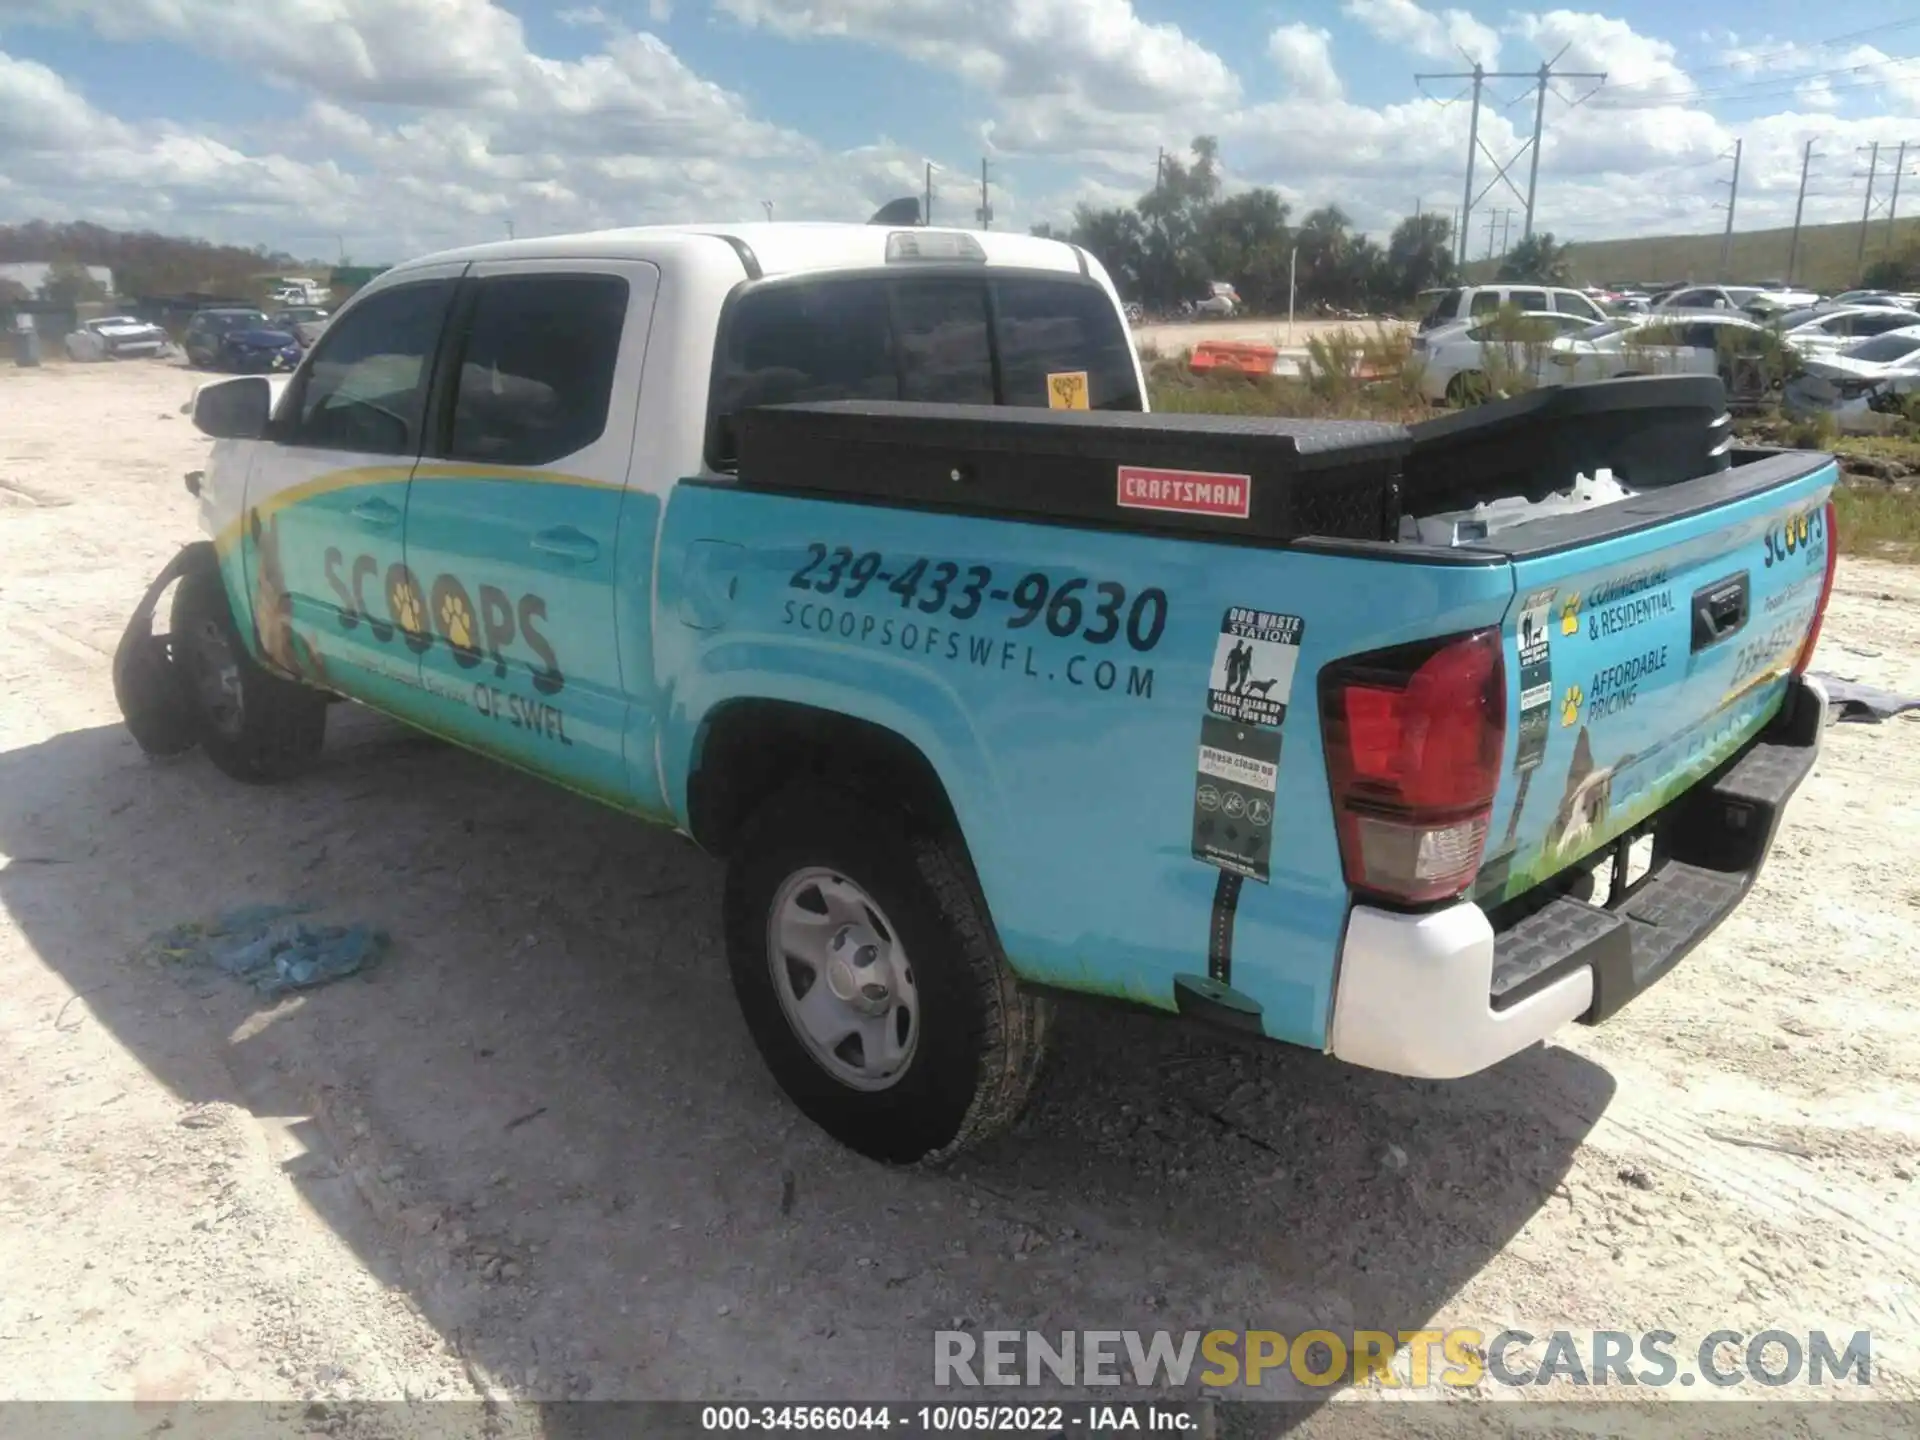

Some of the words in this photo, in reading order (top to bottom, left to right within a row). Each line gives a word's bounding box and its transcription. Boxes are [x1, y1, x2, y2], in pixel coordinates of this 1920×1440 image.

[1126, 477, 1242, 506] CRAFTSMAN
[789, 542, 1168, 652] 239-433-9630
[1588, 564, 1669, 607] COMMERCIAL
[324, 546, 565, 696] SCOOPS
[1229, 608, 1254, 624] DOG
[1257, 612, 1301, 631] WASTE
[1230, 624, 1292, 644] STATION
[1588, 615, 1599, 640] &
[1601, 588, 1675, 637] RESIDENTIAL
[782, 599, 1155, 699] SCOOPSOFSWFL.COM
[1590, 646, 1668, 698] AFFORDABLE
[473, 682, 500, 720] OF
[509, 693, 573, 747] SWFL
[1213, 691, 1241, 705] PLEASE
[1243, 697, 1268, 711] CLEAN
[1269, 704, 1281, 713] UP
[1213, 704, 1237, 715] AFTER
[1238, 709, 1260, 721] YOUR
[1260, 714, 1278, 725] DOG
[1587, 684, 1638, 726] PRICING
[1202, 749, 1233, 765] please
[1234, 758, 1261, 772] clean
